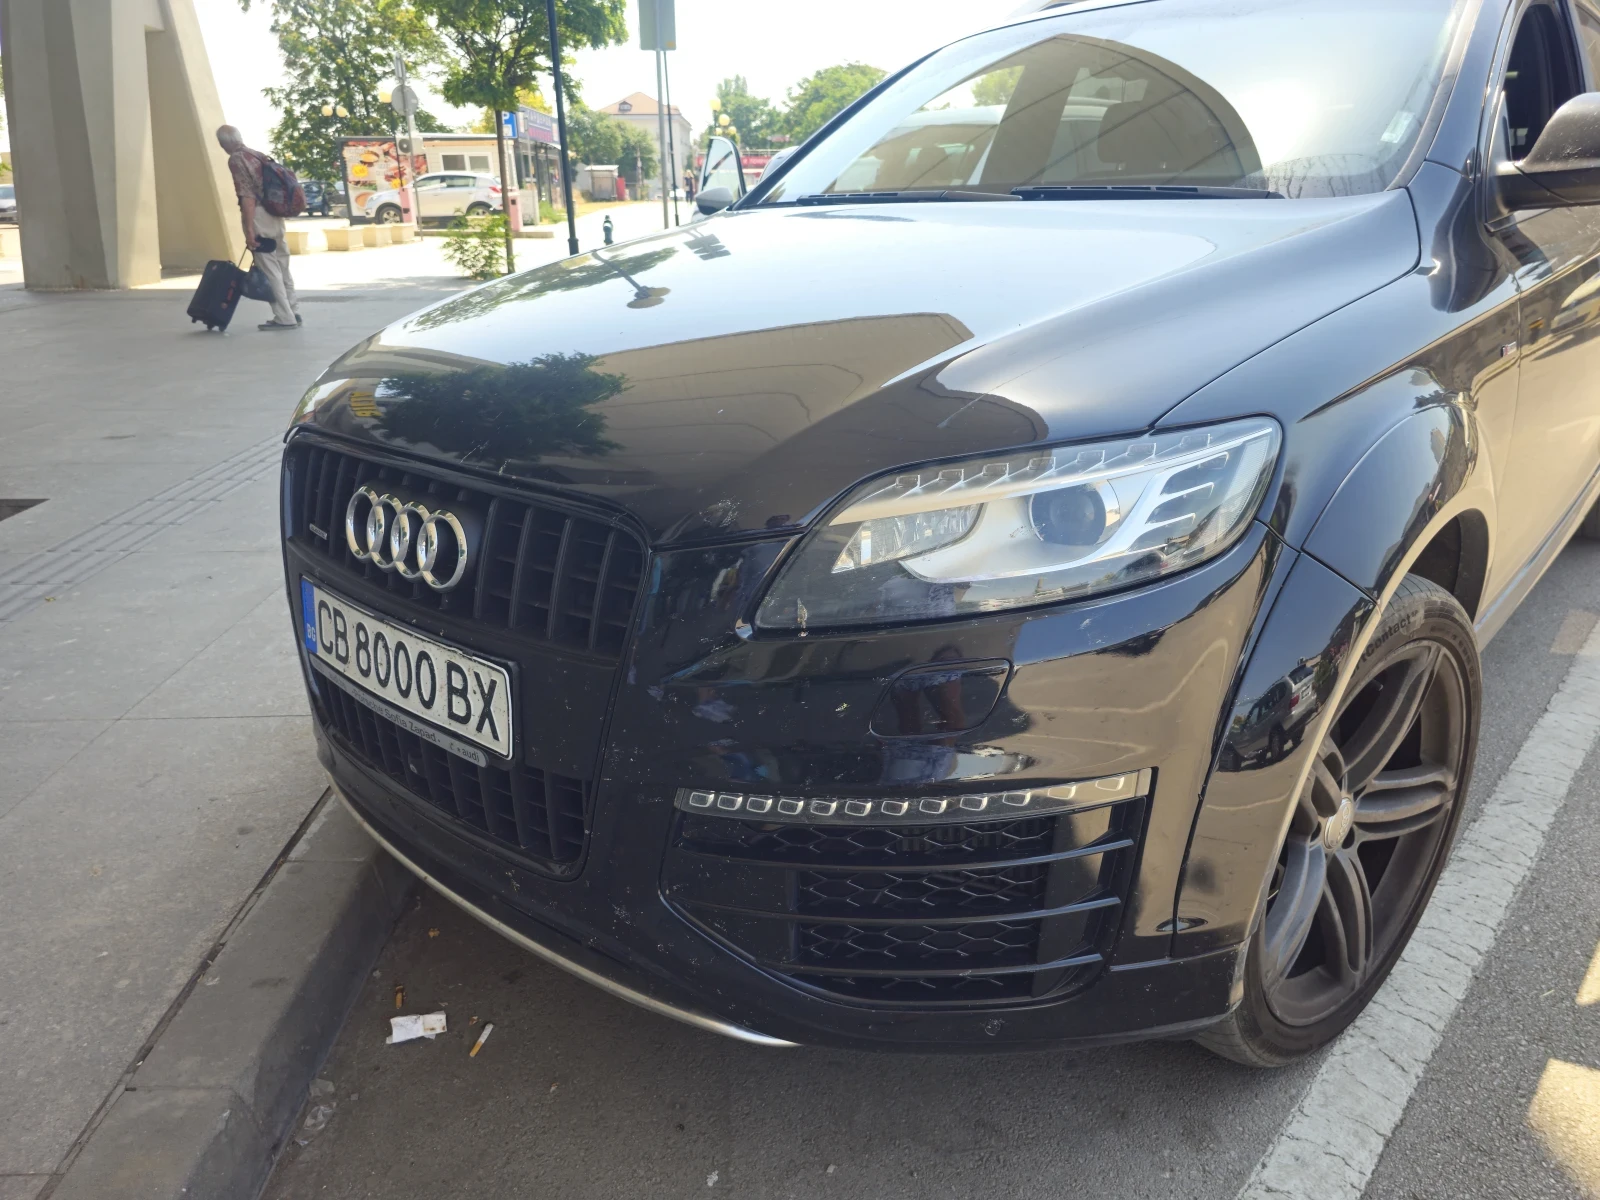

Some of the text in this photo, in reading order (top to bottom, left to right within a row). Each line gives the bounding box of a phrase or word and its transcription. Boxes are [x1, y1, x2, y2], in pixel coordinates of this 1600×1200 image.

[306, 622, 316, 642] BG
[317, 599, 500, 742] CB 8000 BX
[384, 708, 407, 727] Sofia
[408, 720, 437, 742] Zapad
